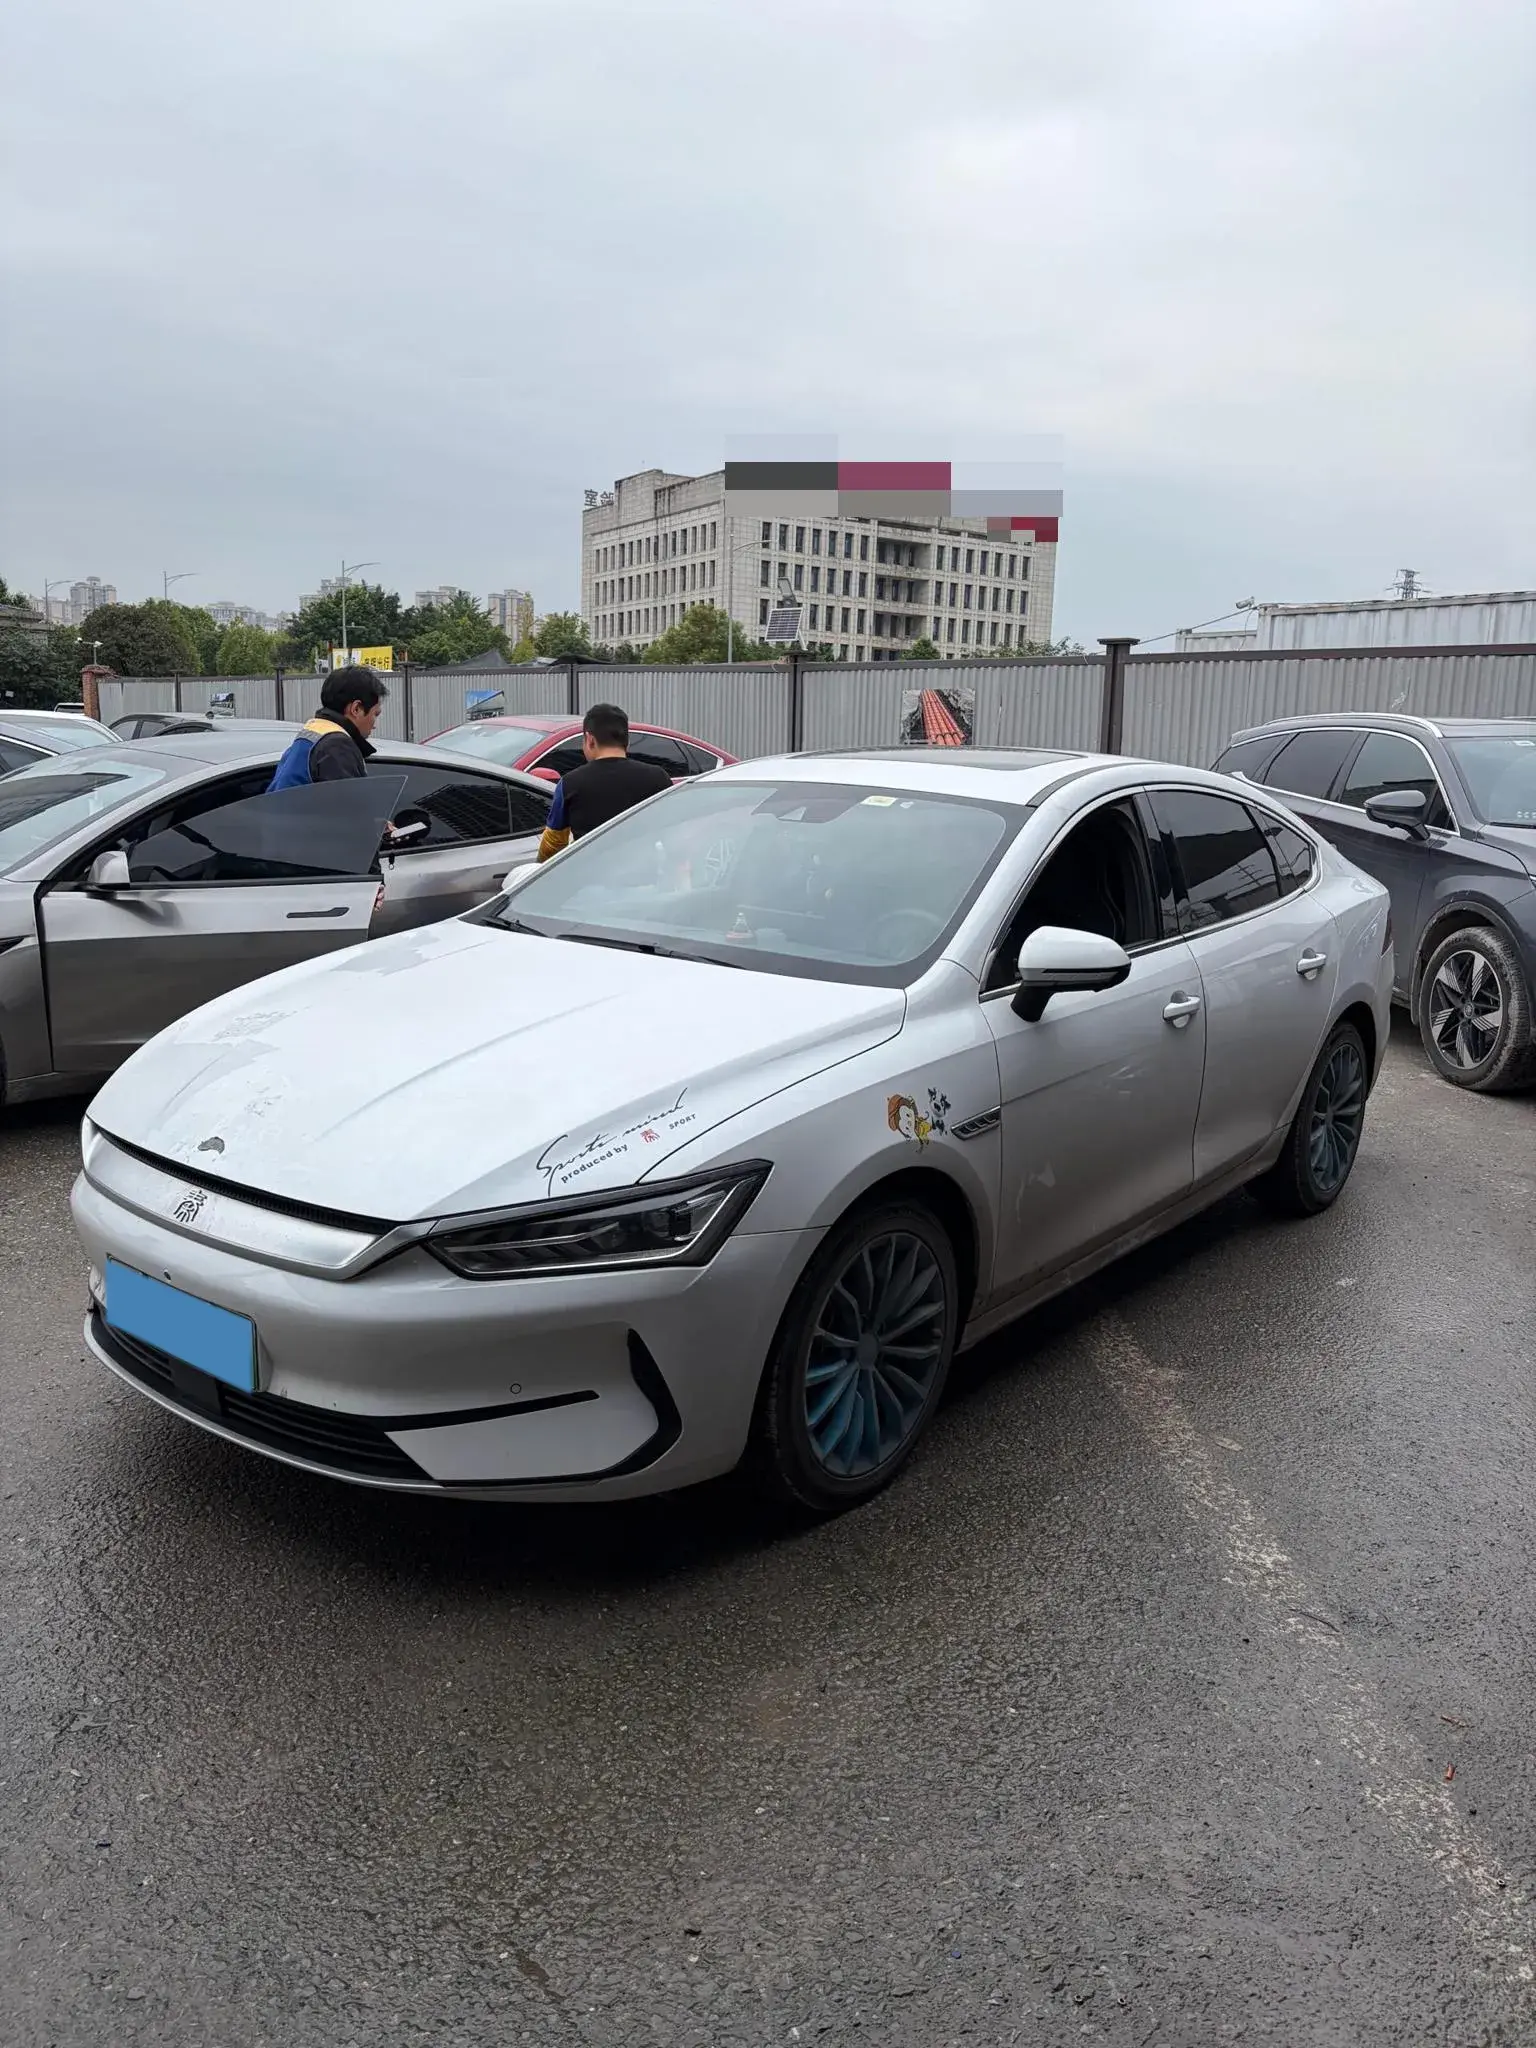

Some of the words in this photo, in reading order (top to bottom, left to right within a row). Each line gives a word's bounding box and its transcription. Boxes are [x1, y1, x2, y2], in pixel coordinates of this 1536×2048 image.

[560, 1150, 614, 1183] produced
[614, 1144, 629, 1157] by
[668, 1113, 697, 1130] SPORT
